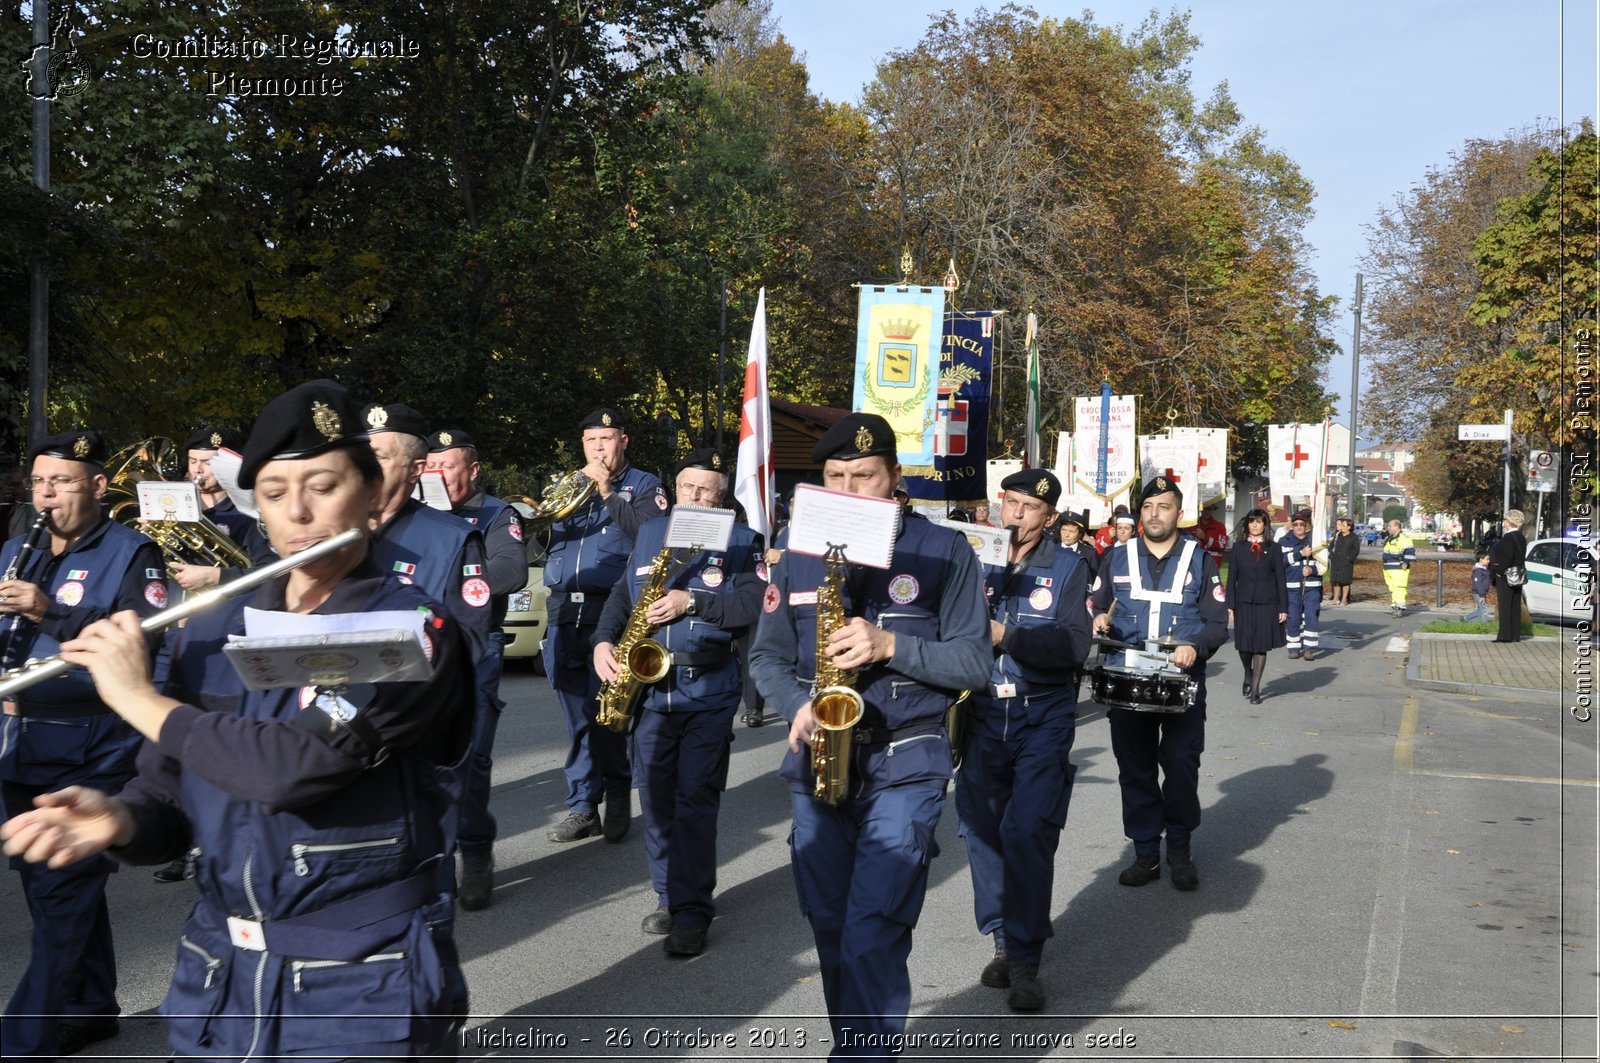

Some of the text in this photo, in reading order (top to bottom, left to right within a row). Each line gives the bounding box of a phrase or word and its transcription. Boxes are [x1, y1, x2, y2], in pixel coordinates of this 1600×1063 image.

[1080, 405, 1131, 415] CROC OSSA
[1089, 415, 1121, 423] ITAANA
